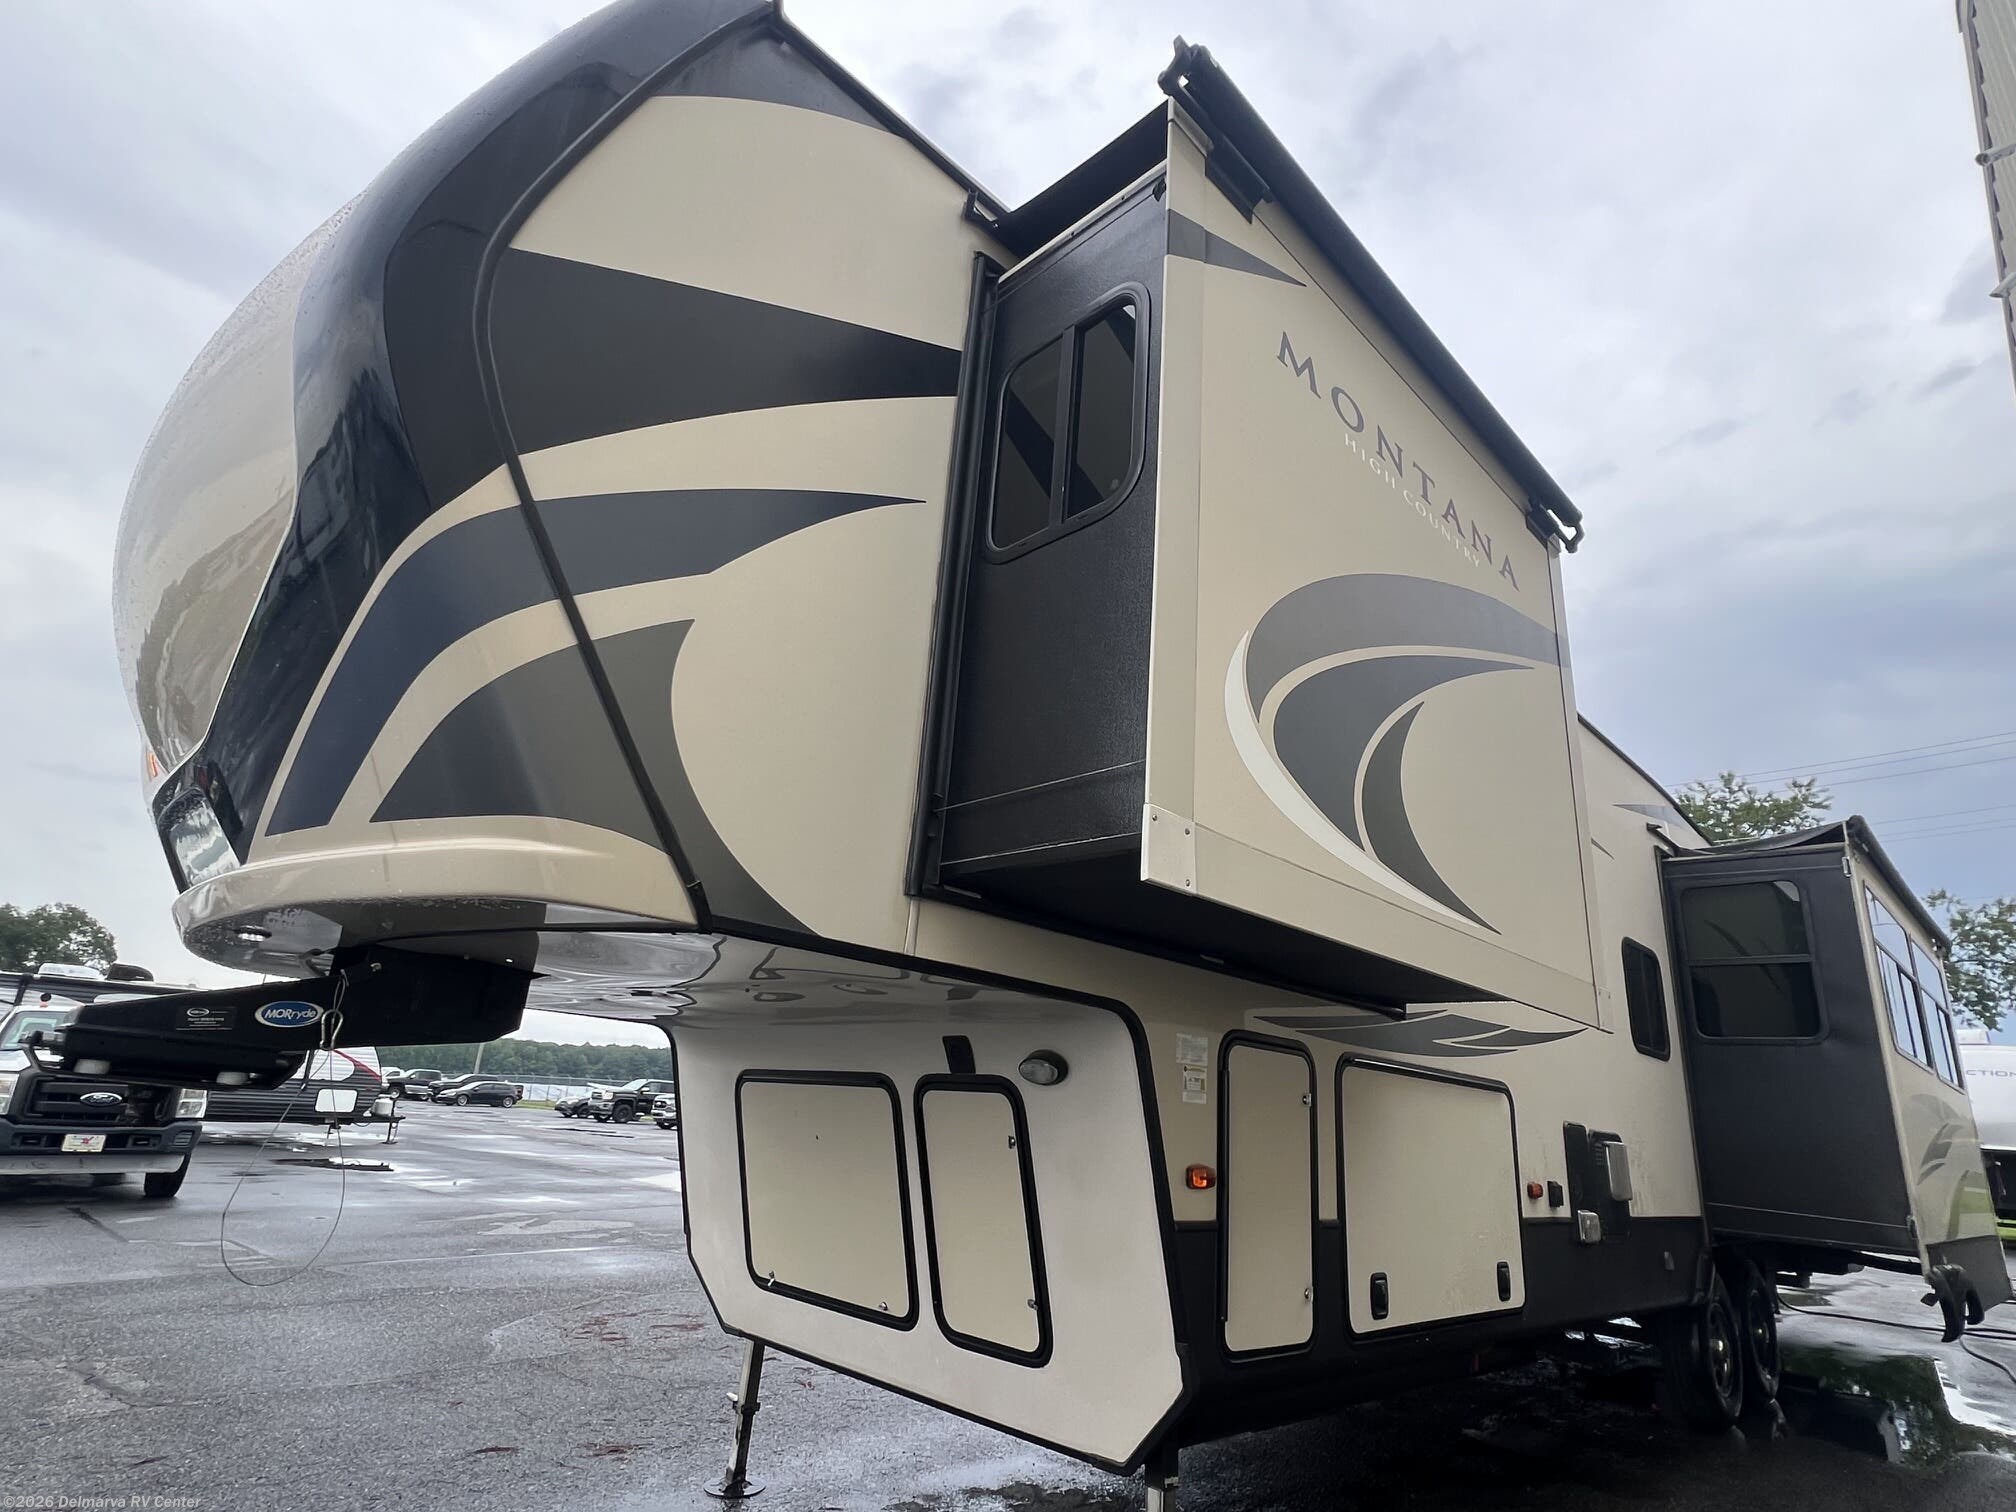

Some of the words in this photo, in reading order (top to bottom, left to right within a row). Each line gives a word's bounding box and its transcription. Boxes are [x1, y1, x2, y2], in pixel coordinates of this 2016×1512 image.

[1277, 331, 1520, 592] MONTANA
[1345, 433, 1396, 489] HIGH
[1403, 489, 1480, 567] COUNTRY
[264, 1007, 317, 1020] MORryde
